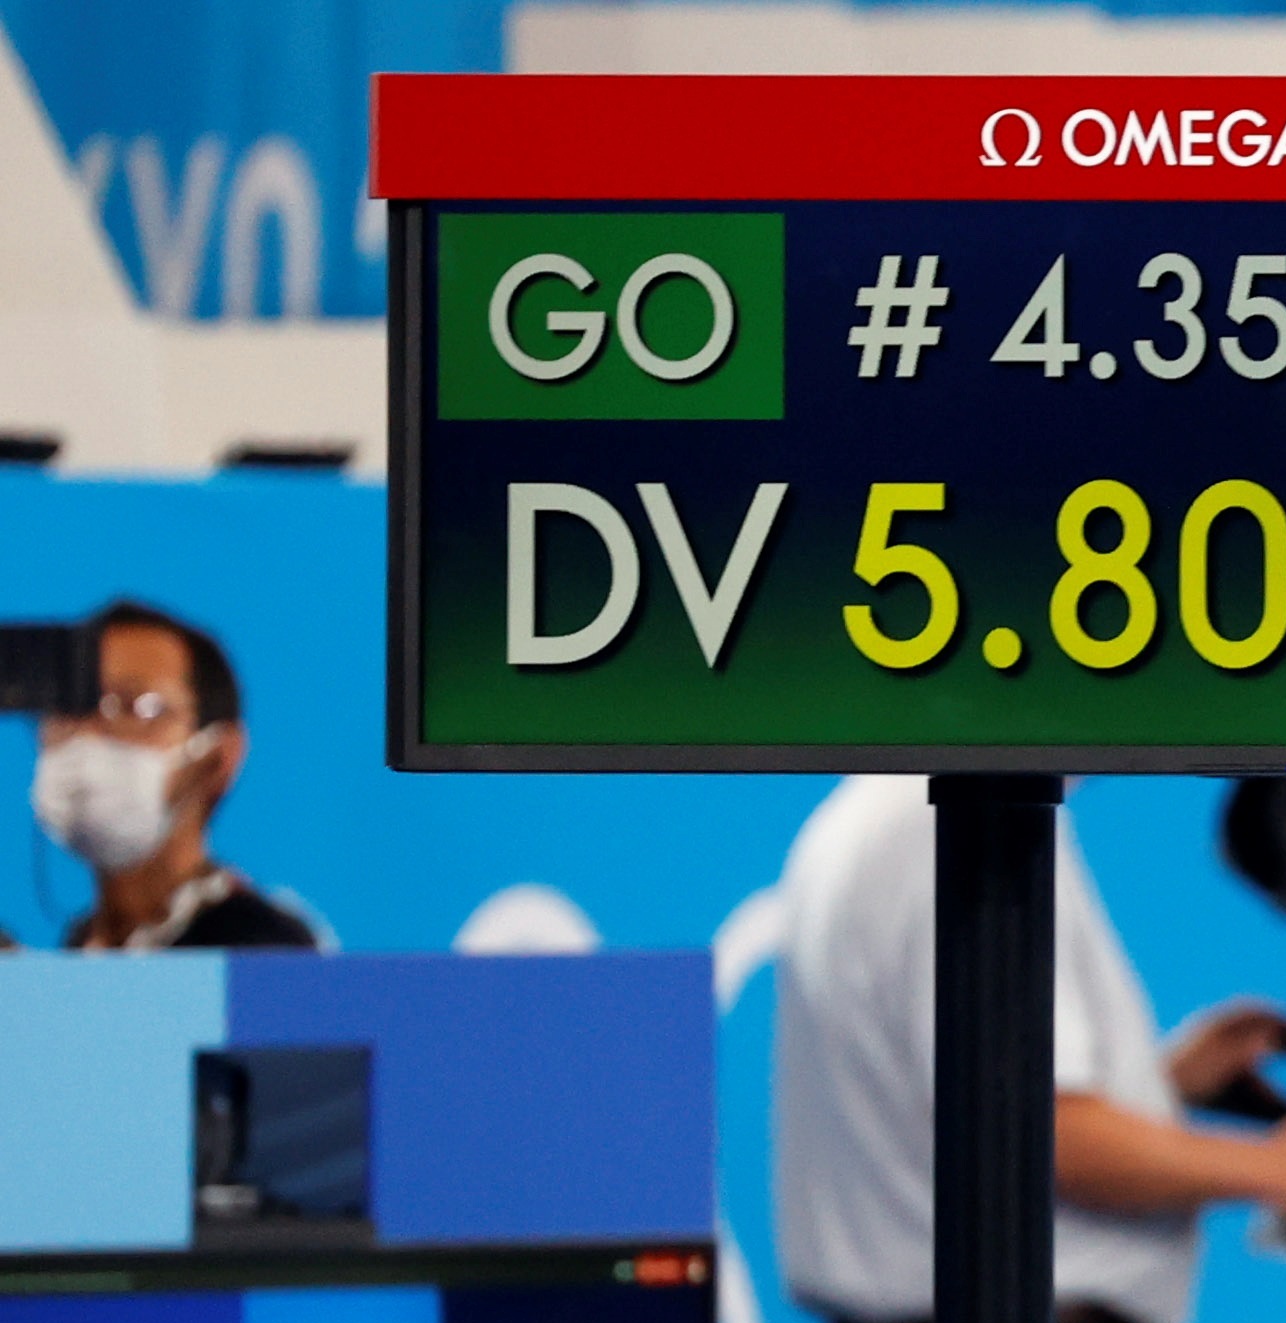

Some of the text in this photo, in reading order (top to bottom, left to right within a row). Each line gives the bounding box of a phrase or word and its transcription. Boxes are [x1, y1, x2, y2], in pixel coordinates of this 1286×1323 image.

[488, 253, 734, 380] GO
[847, 255, 950, 378] #
[506, 482, 789, 668] DV
